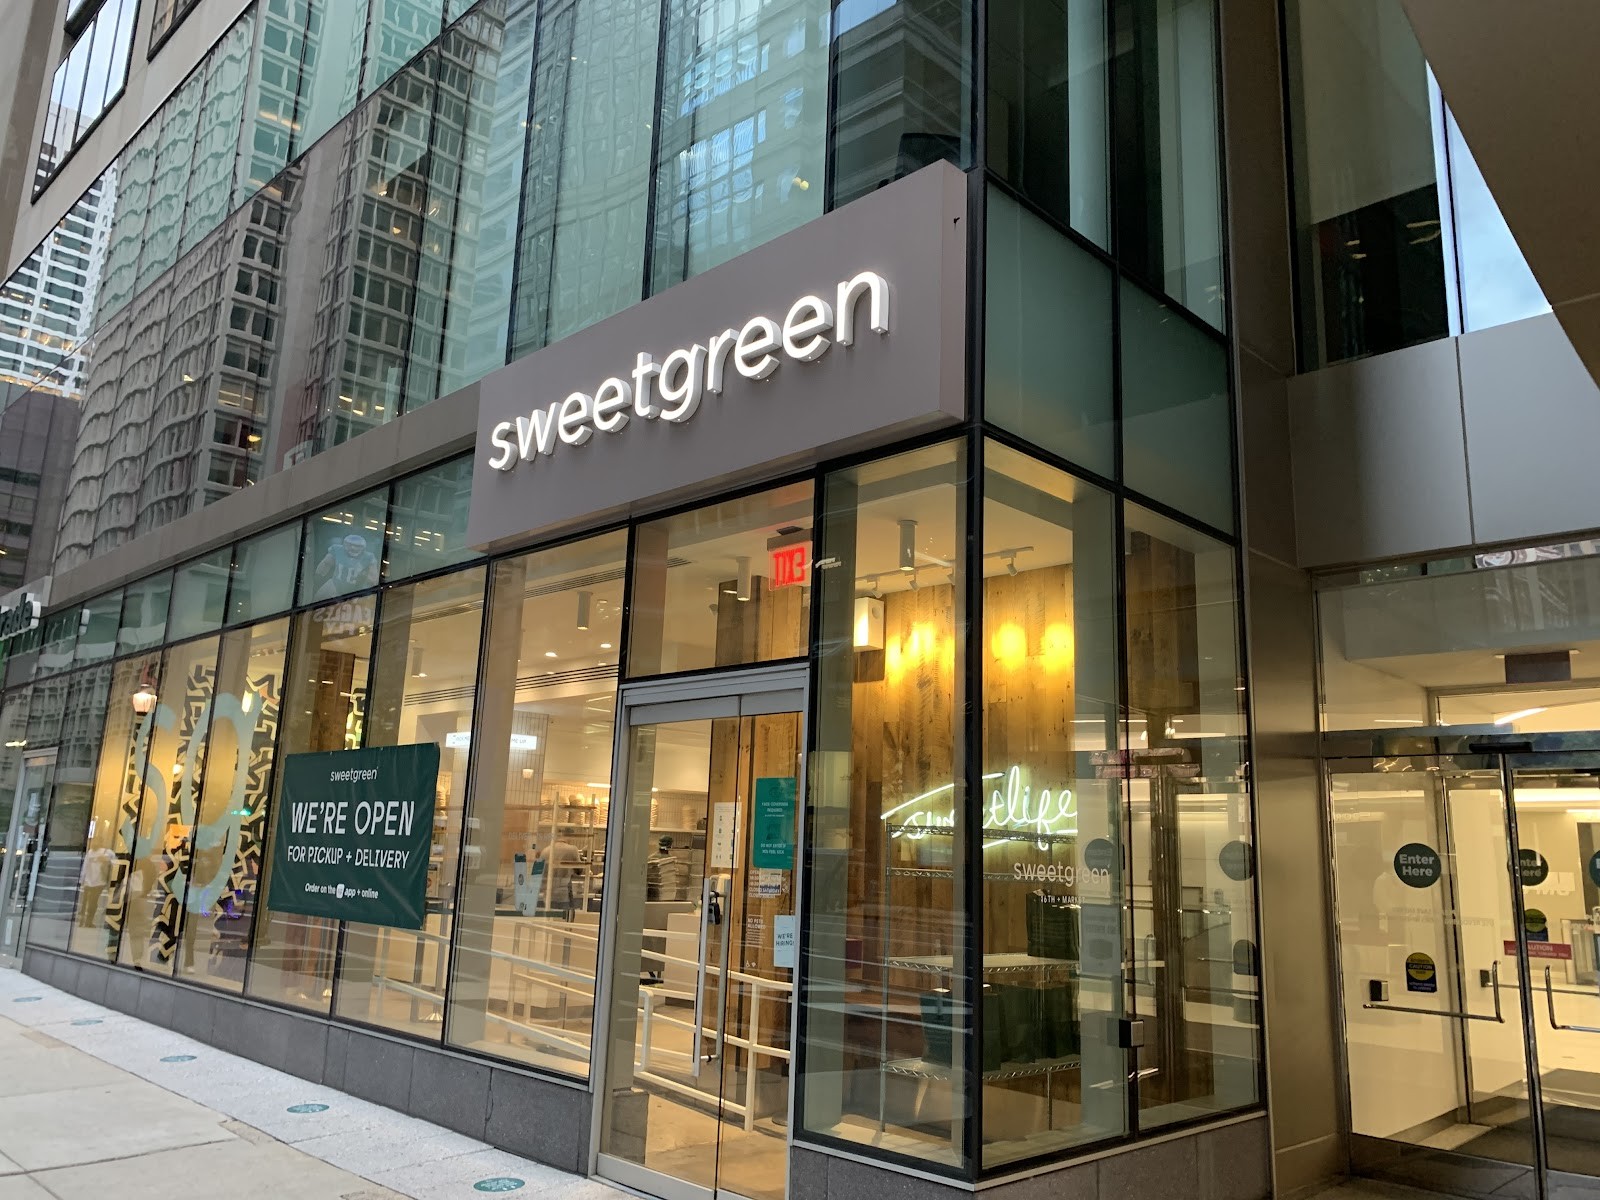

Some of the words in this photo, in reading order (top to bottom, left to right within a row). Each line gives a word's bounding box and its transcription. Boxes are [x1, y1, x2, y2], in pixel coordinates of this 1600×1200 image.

[488, 271, 890, 471] sweetgreen
[330, 767, 378, 783] sweetgreen
[291, 801, 348, 834] WE'RE
[354, 800, 415, 836] OPEN
[287, 845, 305, 862] FOR
[307, 846, 343, 865] PICKUP
[346, 850, 352, 863] +
[355, 849, 409, 869] DELIVERY
[1399, 853, 1434, 865] Enter
[1013, 861, 1109, 887] sweetgreen
[1402, 865, 1433, 877] Here
[305, 883, 320, 893] Order
[320, 885, 327, 894] on
[344, 888, 356, 898] app
[361, 888, 379, 899] online
